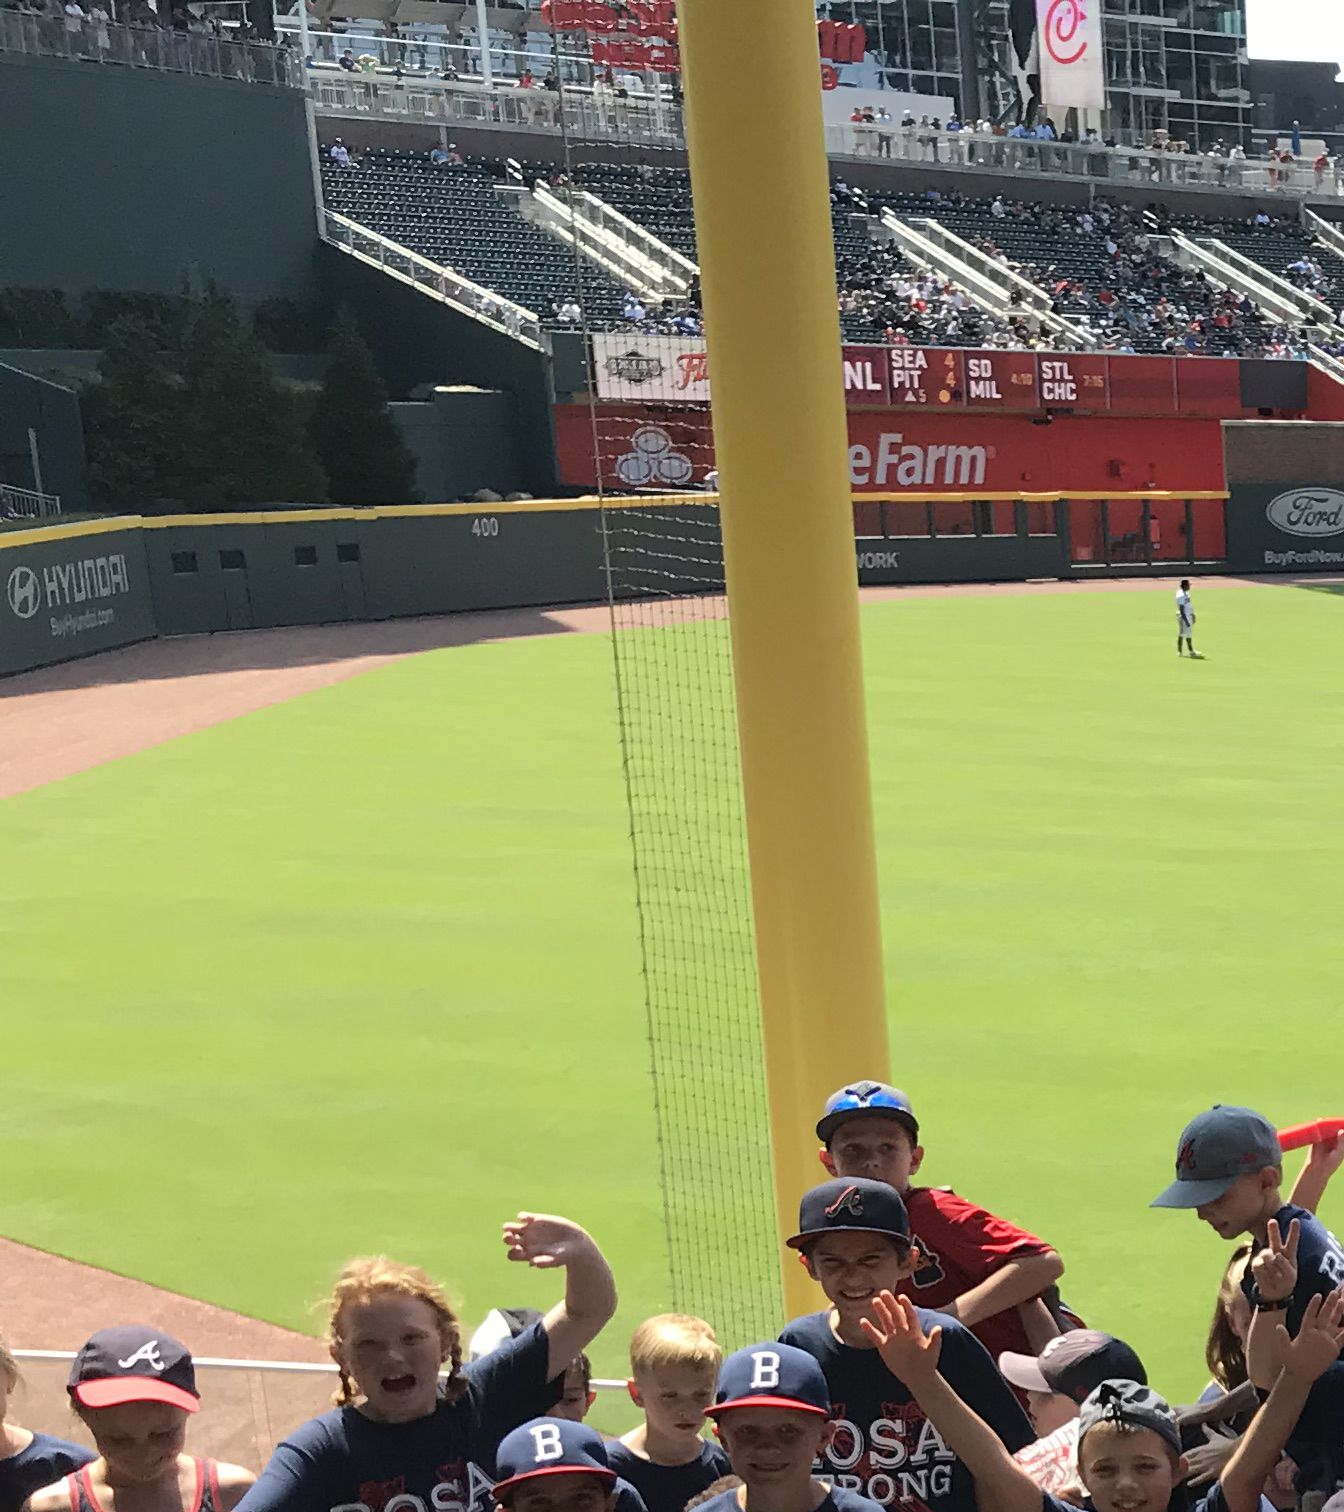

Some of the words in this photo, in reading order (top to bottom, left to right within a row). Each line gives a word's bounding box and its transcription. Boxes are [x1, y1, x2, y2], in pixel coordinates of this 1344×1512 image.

[891, 350, 928, 369] SEA
[944, 352, 955, 368] 4
[968, 359, 992, 378] SD
[1041, 361, 1073, 380] STL
[844, 361, 882, 391] NL
[893, 370, 922, 388] PIT
[945, 371, 956, 388] 4
[970, 380, 1002, 399] MIL
[1042, 382, 1077, 401] CHC
[875, 433, 986, 486] Farm
[1286, 495, 1344, 528] Ford
[472, 517, 499, 537] 400
[43, 554, 129, 608] HYUNDAI
[824, 1186, 864, 1219] A
[118, 1340, 165, 1371] A
[750, 1351, 782, 1389] B
[529, 1423, 564, 1463] B
[812, 1417, 957, 1470] OSA
